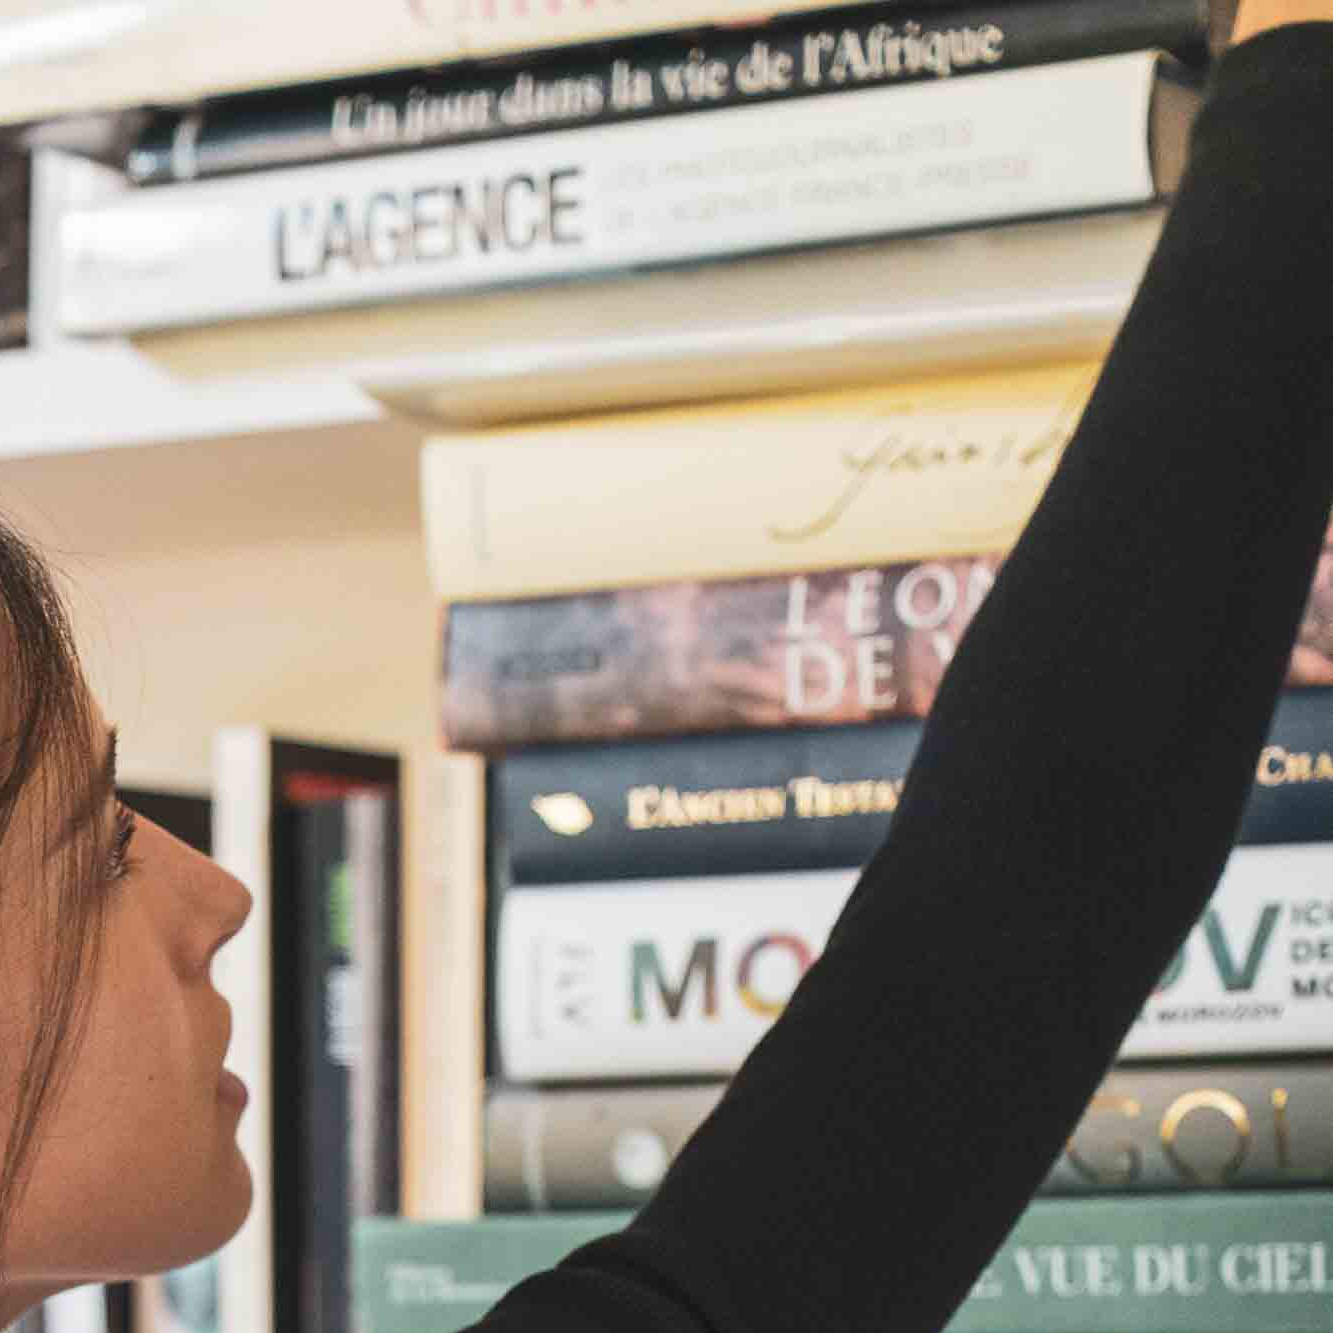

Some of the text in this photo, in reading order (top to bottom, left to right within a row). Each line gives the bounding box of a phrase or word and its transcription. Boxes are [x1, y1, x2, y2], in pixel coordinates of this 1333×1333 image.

[500, 69, 602, 125] dans
[610, 58, 654, 110] la
[664, 46, 727, 104] vie
[737, 34, 794, 96] de
[802, 20, 1005, 86] l'Afrique
[273, 166, 586, 283] L'AGENCE
[783, 633, 899, 714] DE
[1015, 1244, 1122, 1298] VUE
[1133, 1243, 1210, 1297] DU
[1219, 1240, 1333, 1294] CIEL
